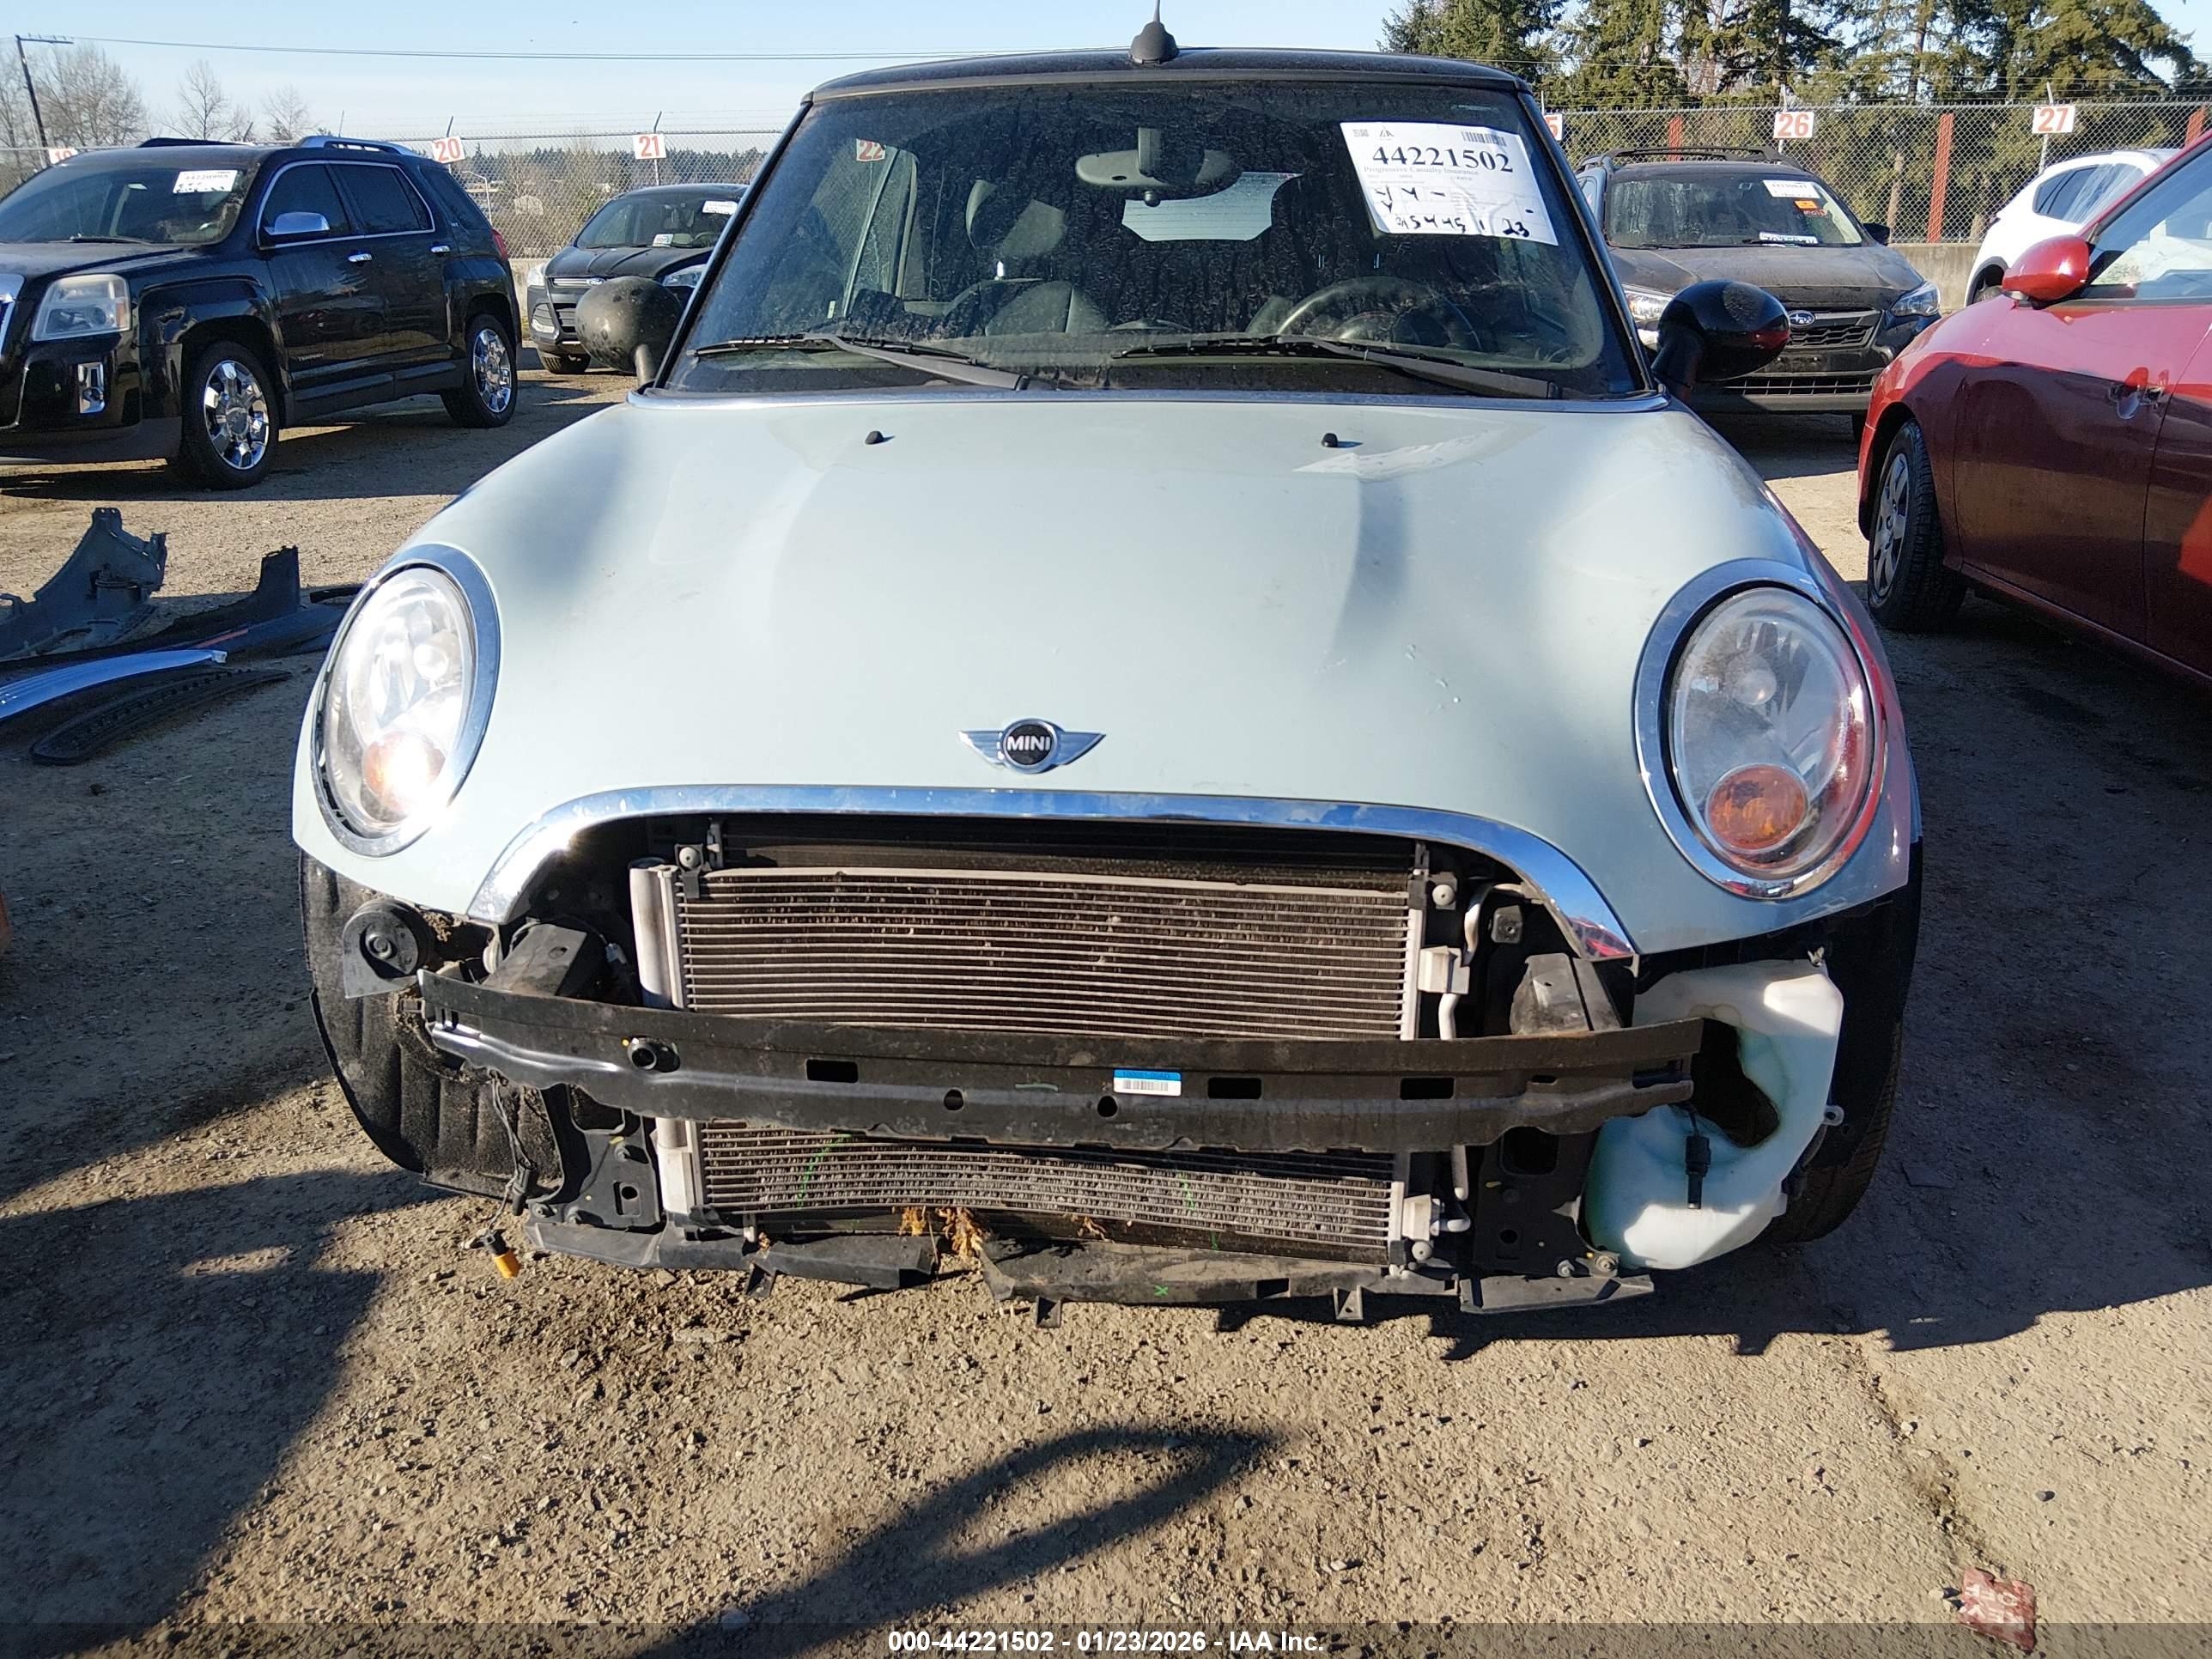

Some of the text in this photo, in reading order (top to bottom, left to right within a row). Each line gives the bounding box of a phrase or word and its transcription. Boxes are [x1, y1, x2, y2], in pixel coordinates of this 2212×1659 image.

[1778, 113, 1809, 137] 26
[2038, 107, 2069, 131] 27
[435, 138, 461, 161] 20
[639, 136, 660, 157] 21
[1364, 166, 1478, 176] Progressive Casualty Insurance
[1372, 146, 1513, 173] 44221502
[1007, 736, 1051, 751] MINI
